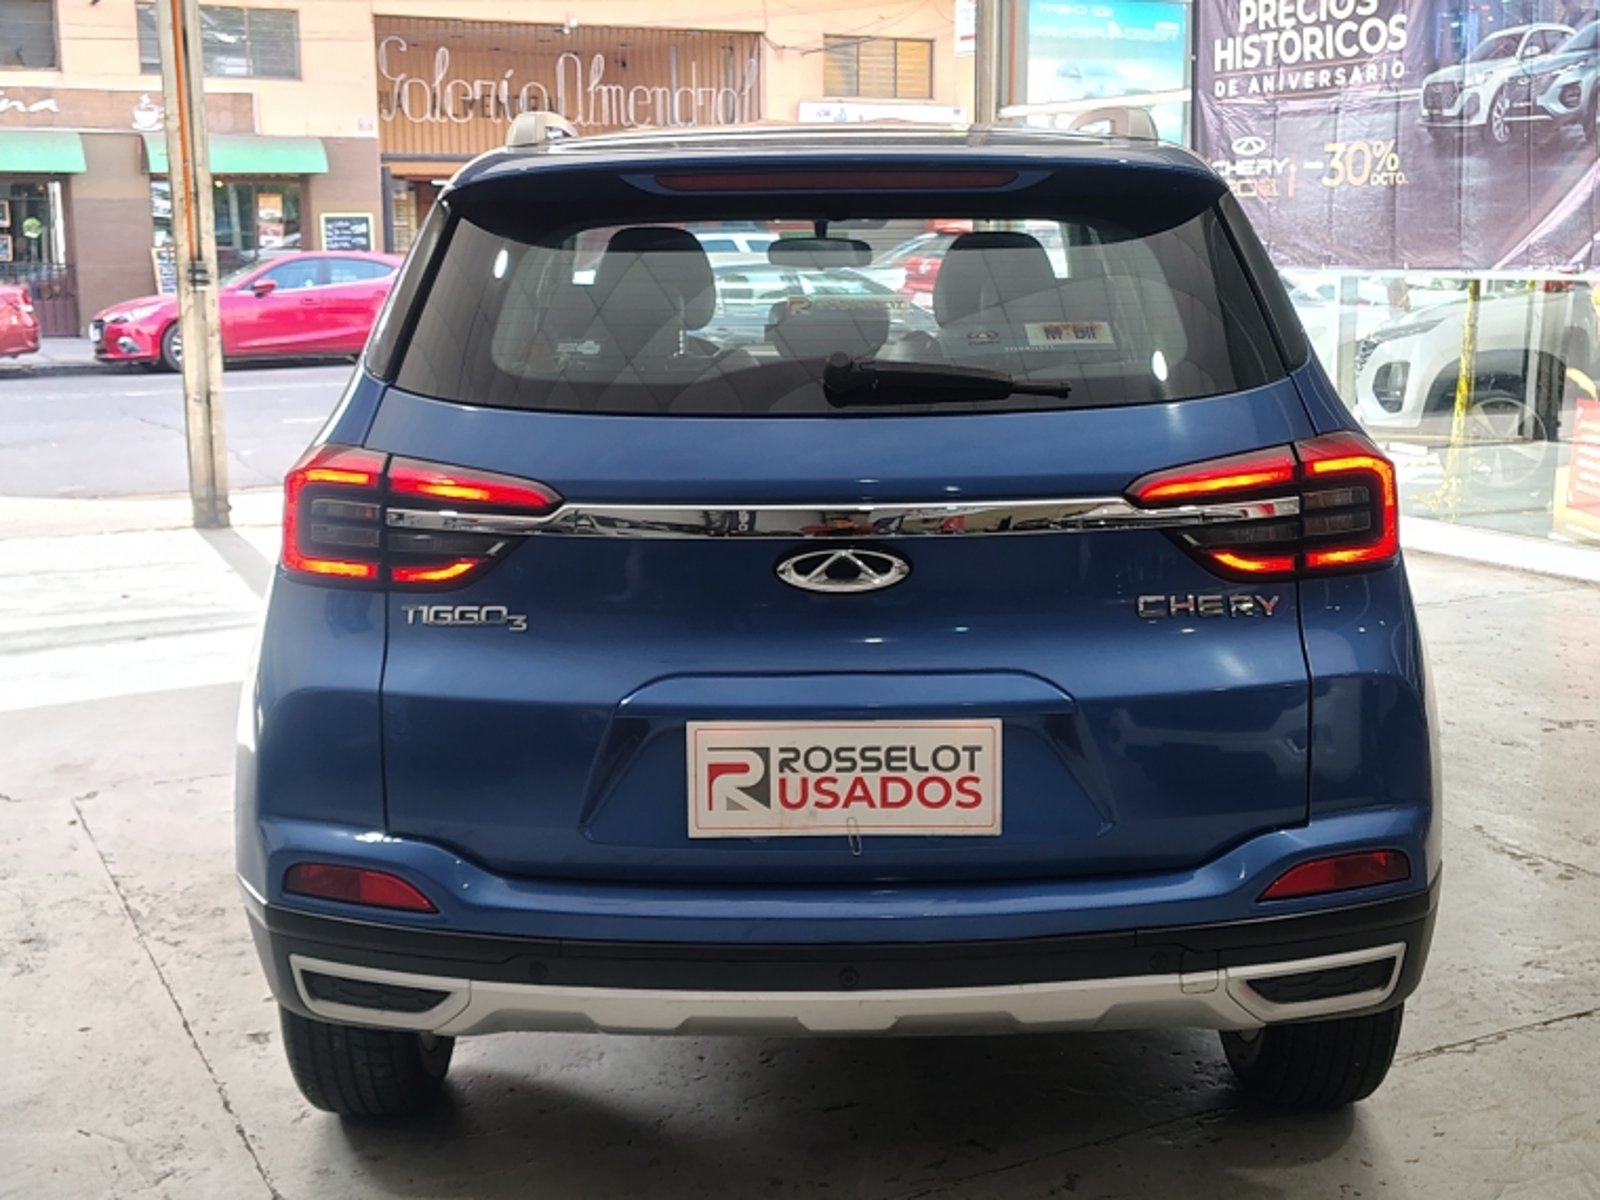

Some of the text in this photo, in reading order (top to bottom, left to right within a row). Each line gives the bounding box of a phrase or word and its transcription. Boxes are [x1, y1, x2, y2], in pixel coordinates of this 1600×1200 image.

[1214, 14, 1408, 72] HISTÓRICOS
[1214, 60, 1405, 97] DE ANIVERSARIO
[1138, 594, 1279, 618] CHERY
[778, 745, 982, 773] ROSSELOT
[778, 775, 982, 811] USADOS
